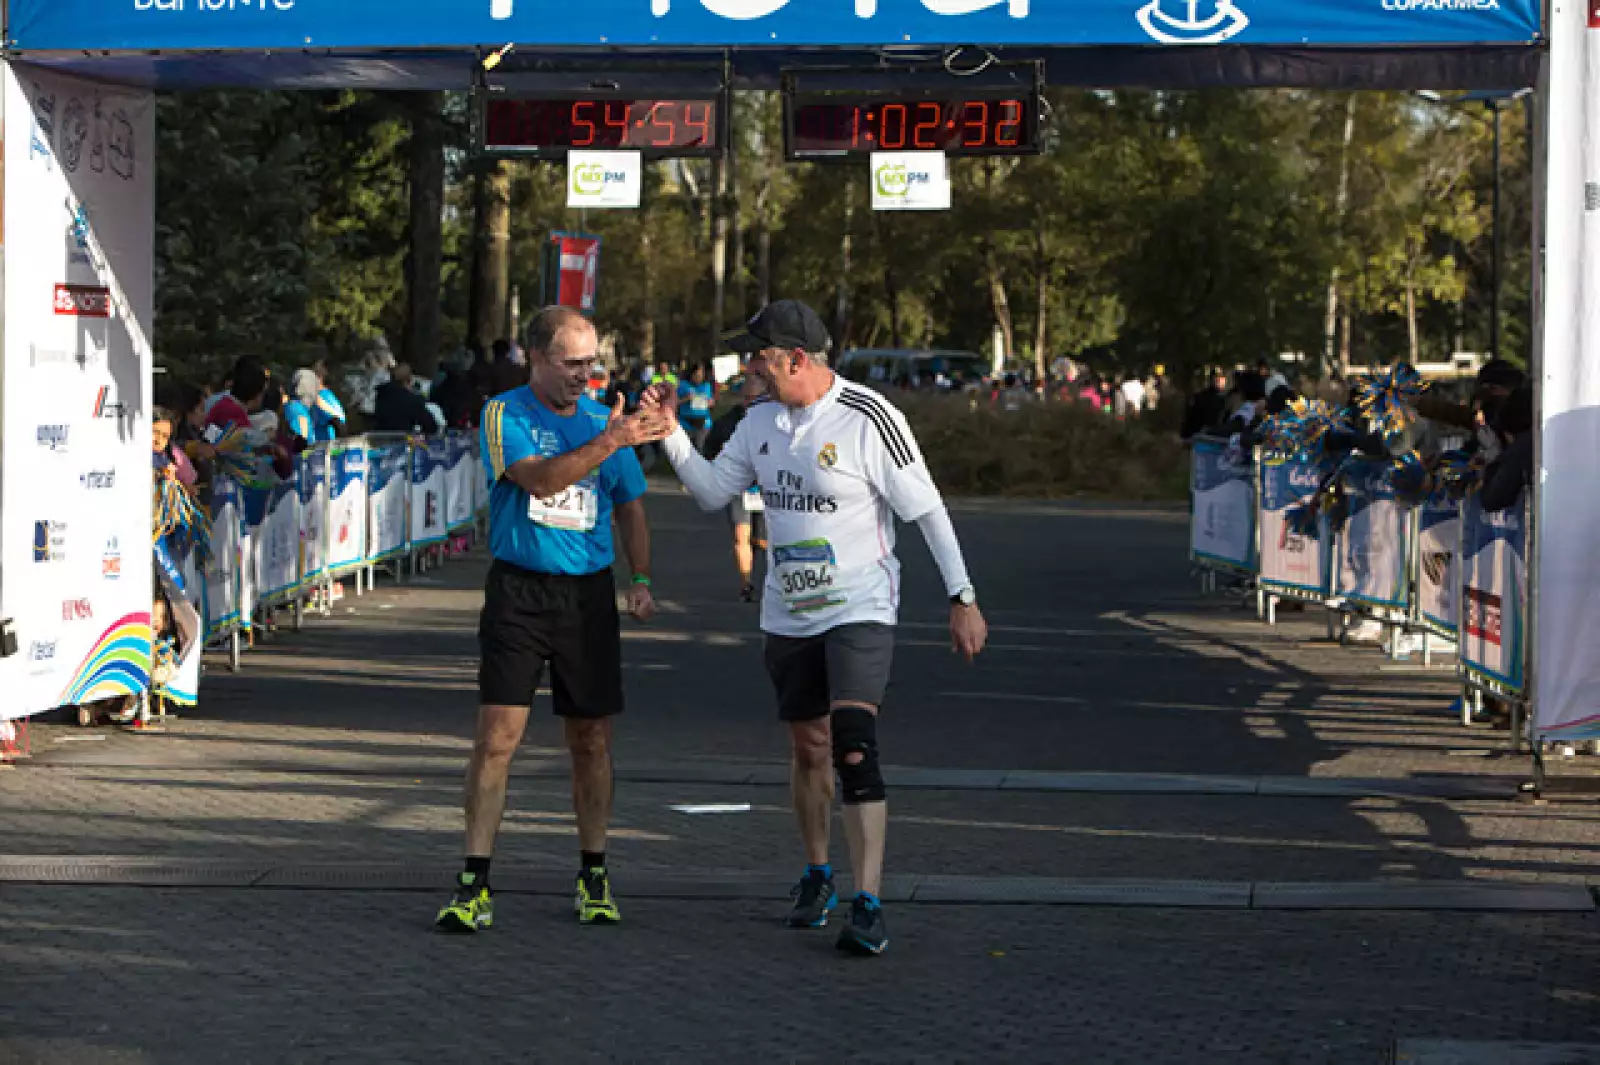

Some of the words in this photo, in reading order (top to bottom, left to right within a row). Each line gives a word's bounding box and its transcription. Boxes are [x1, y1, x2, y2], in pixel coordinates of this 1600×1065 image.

[777, 469, 804, 491] Fly
[764, 487, 838, 513] mirates
[780, 564, 833, 594] 3084
